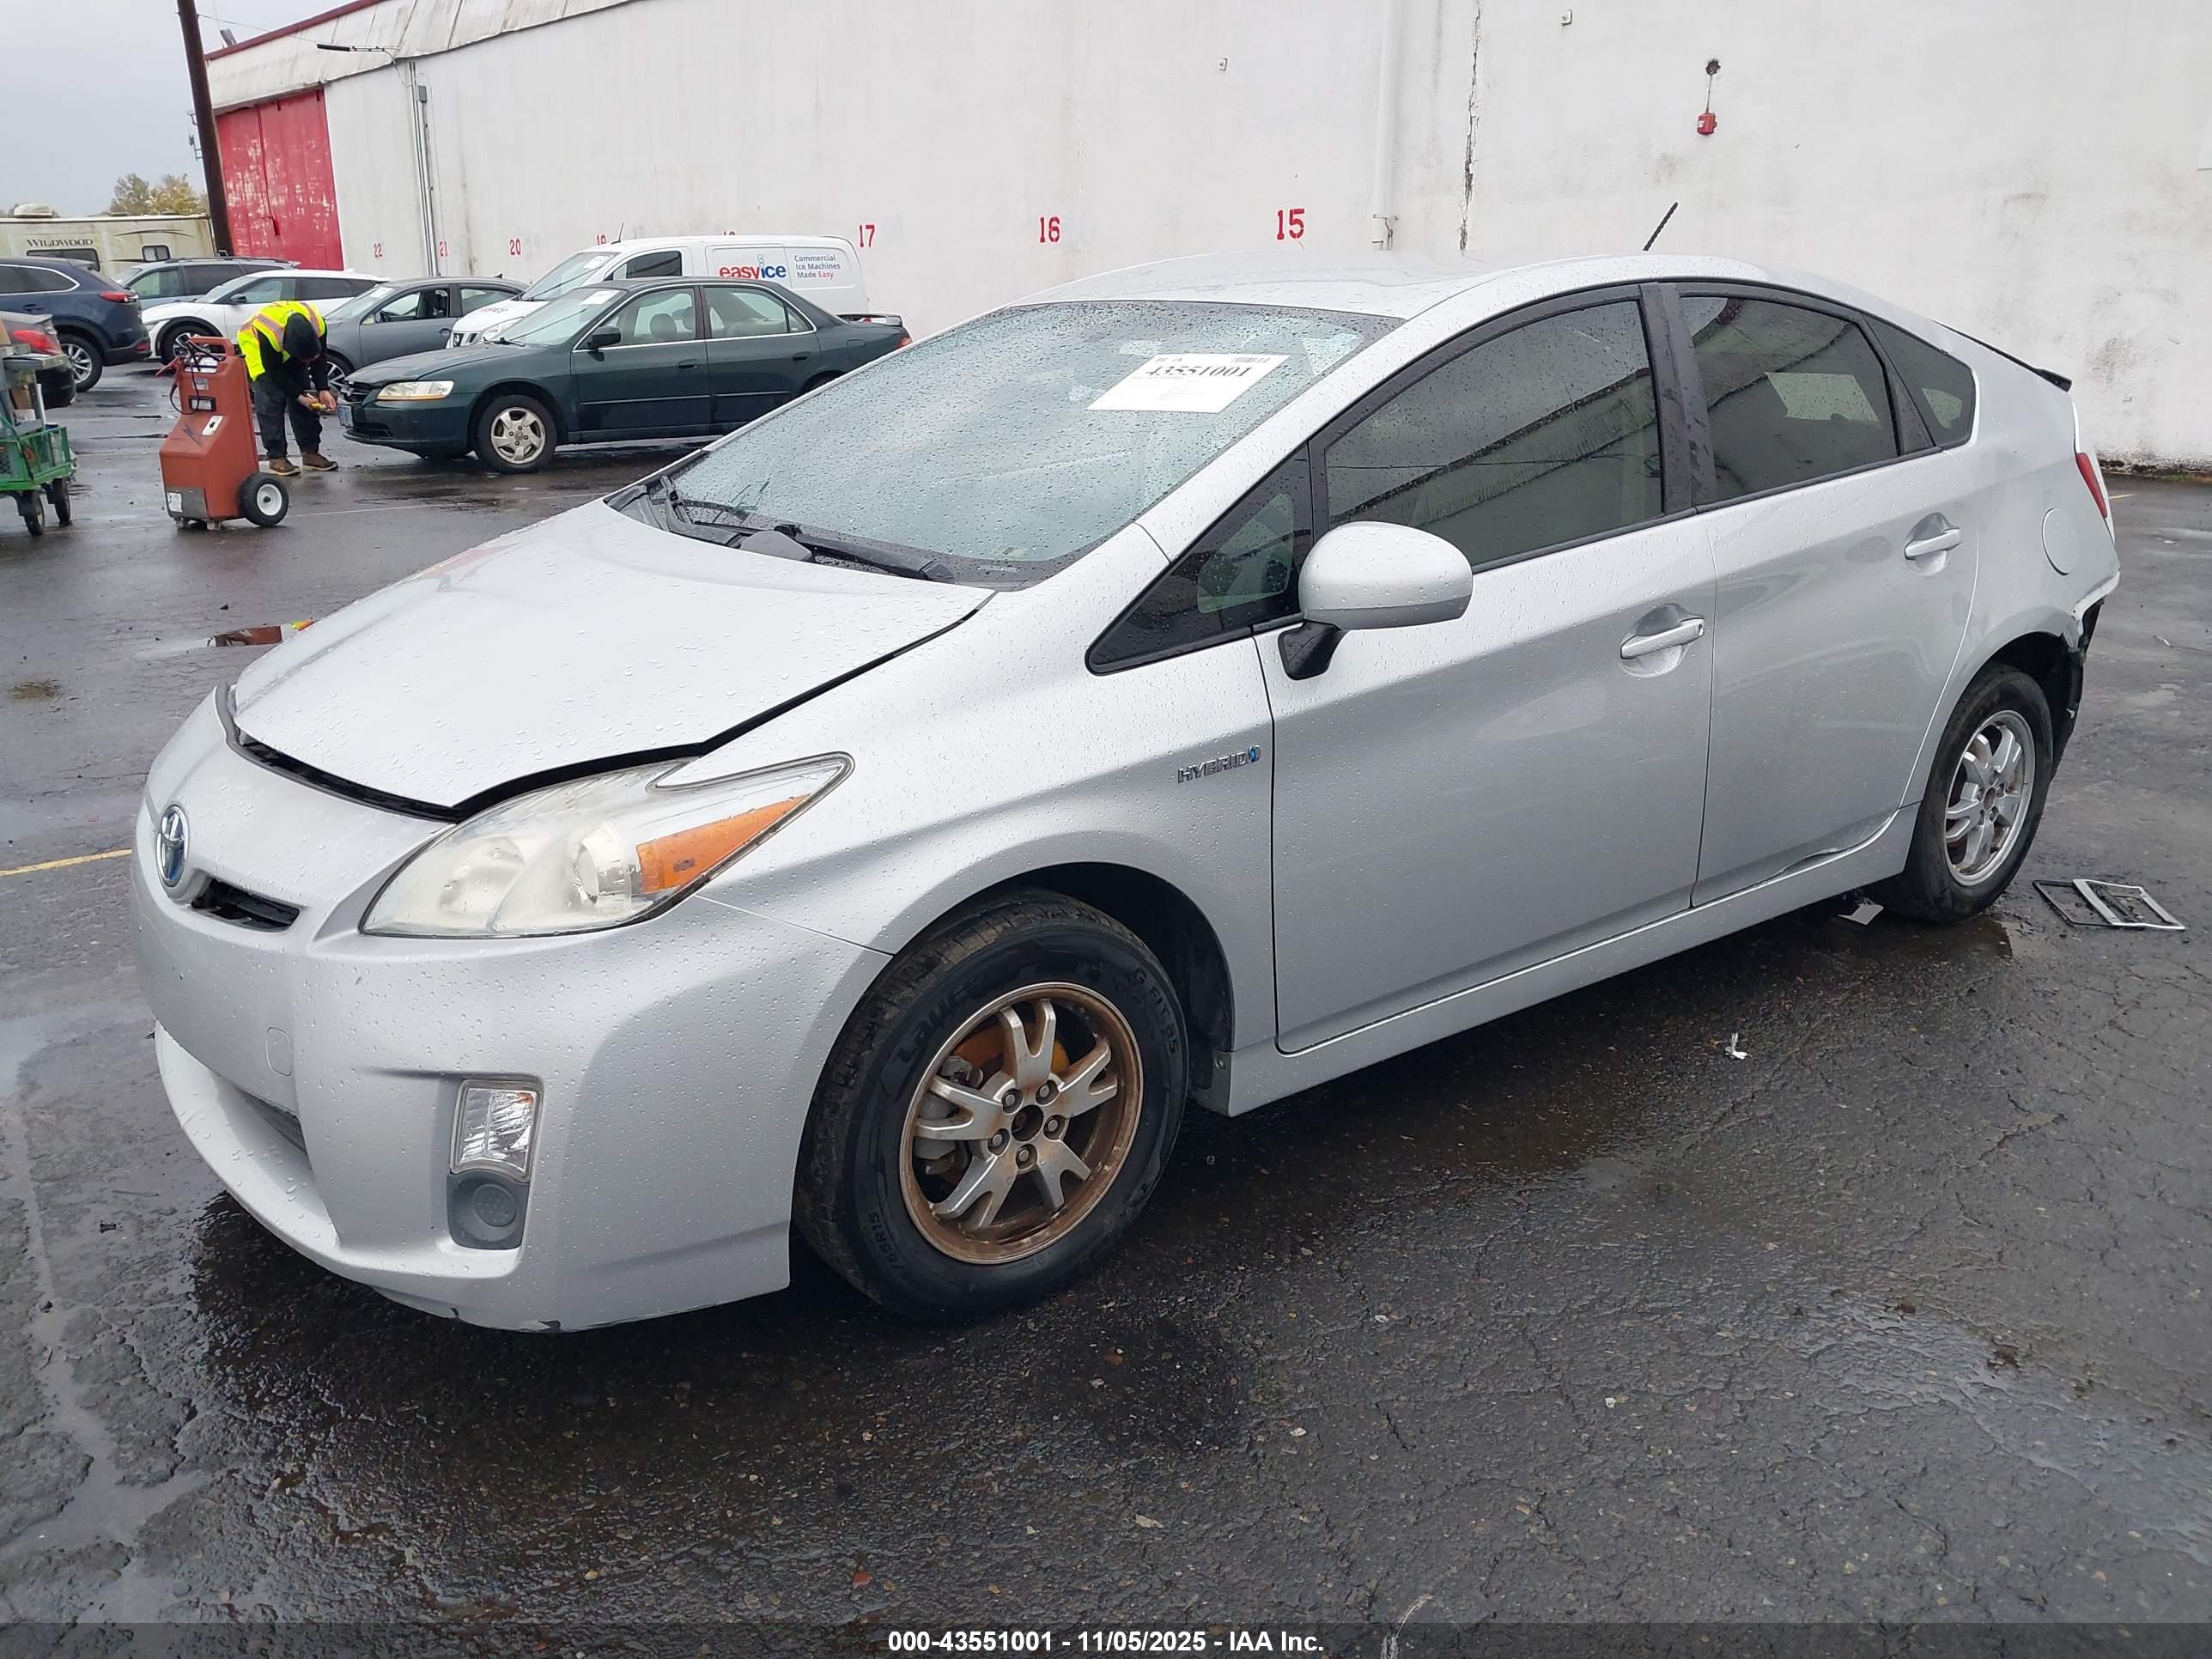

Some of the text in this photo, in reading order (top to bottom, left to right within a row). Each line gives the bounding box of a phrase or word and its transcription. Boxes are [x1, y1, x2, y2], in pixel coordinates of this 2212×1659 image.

[1040, 216, 1060, 242] 16
[1277, 209, 1305, 240] 15
[27, 239, 94, 247] WILDWOOD
[859, 225, 875, 247] 17
[374, 243, 382, 258] 22
[440, 241, 447, 257] 21
[509, 239, 521, 255] 20
[1177, 750, 1249, 783] HYBRID
